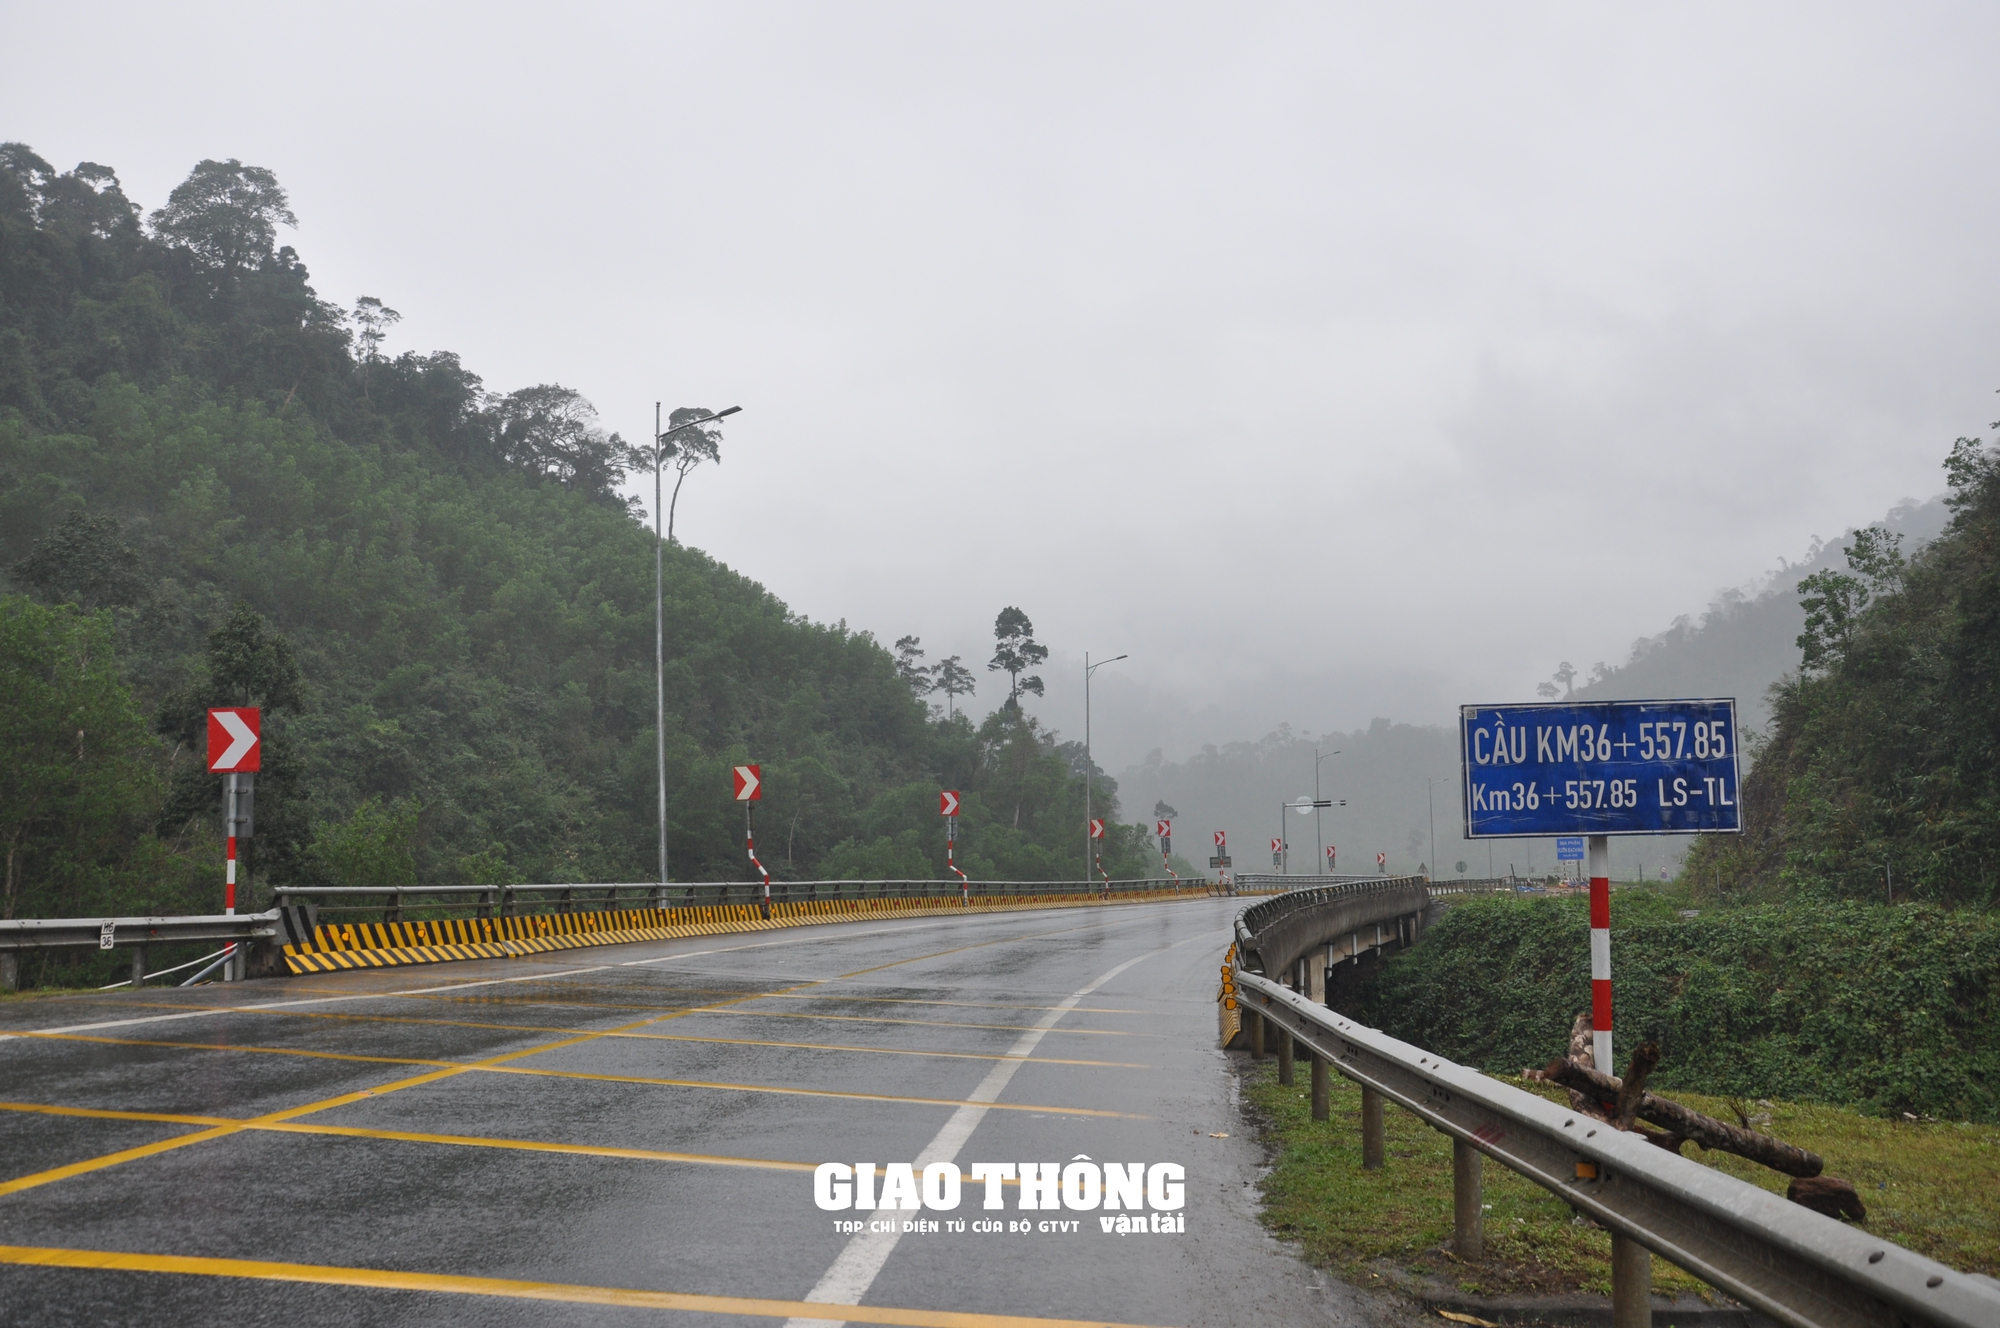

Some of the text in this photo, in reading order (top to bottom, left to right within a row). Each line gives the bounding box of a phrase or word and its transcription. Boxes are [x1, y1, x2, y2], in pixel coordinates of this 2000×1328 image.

[1474, 712, 1726, 764] CẦU KM36+557.85
[1472, 777, 1734, 811] Km36+557.85 LS-TL
[102, 936, 112, 947] 36
